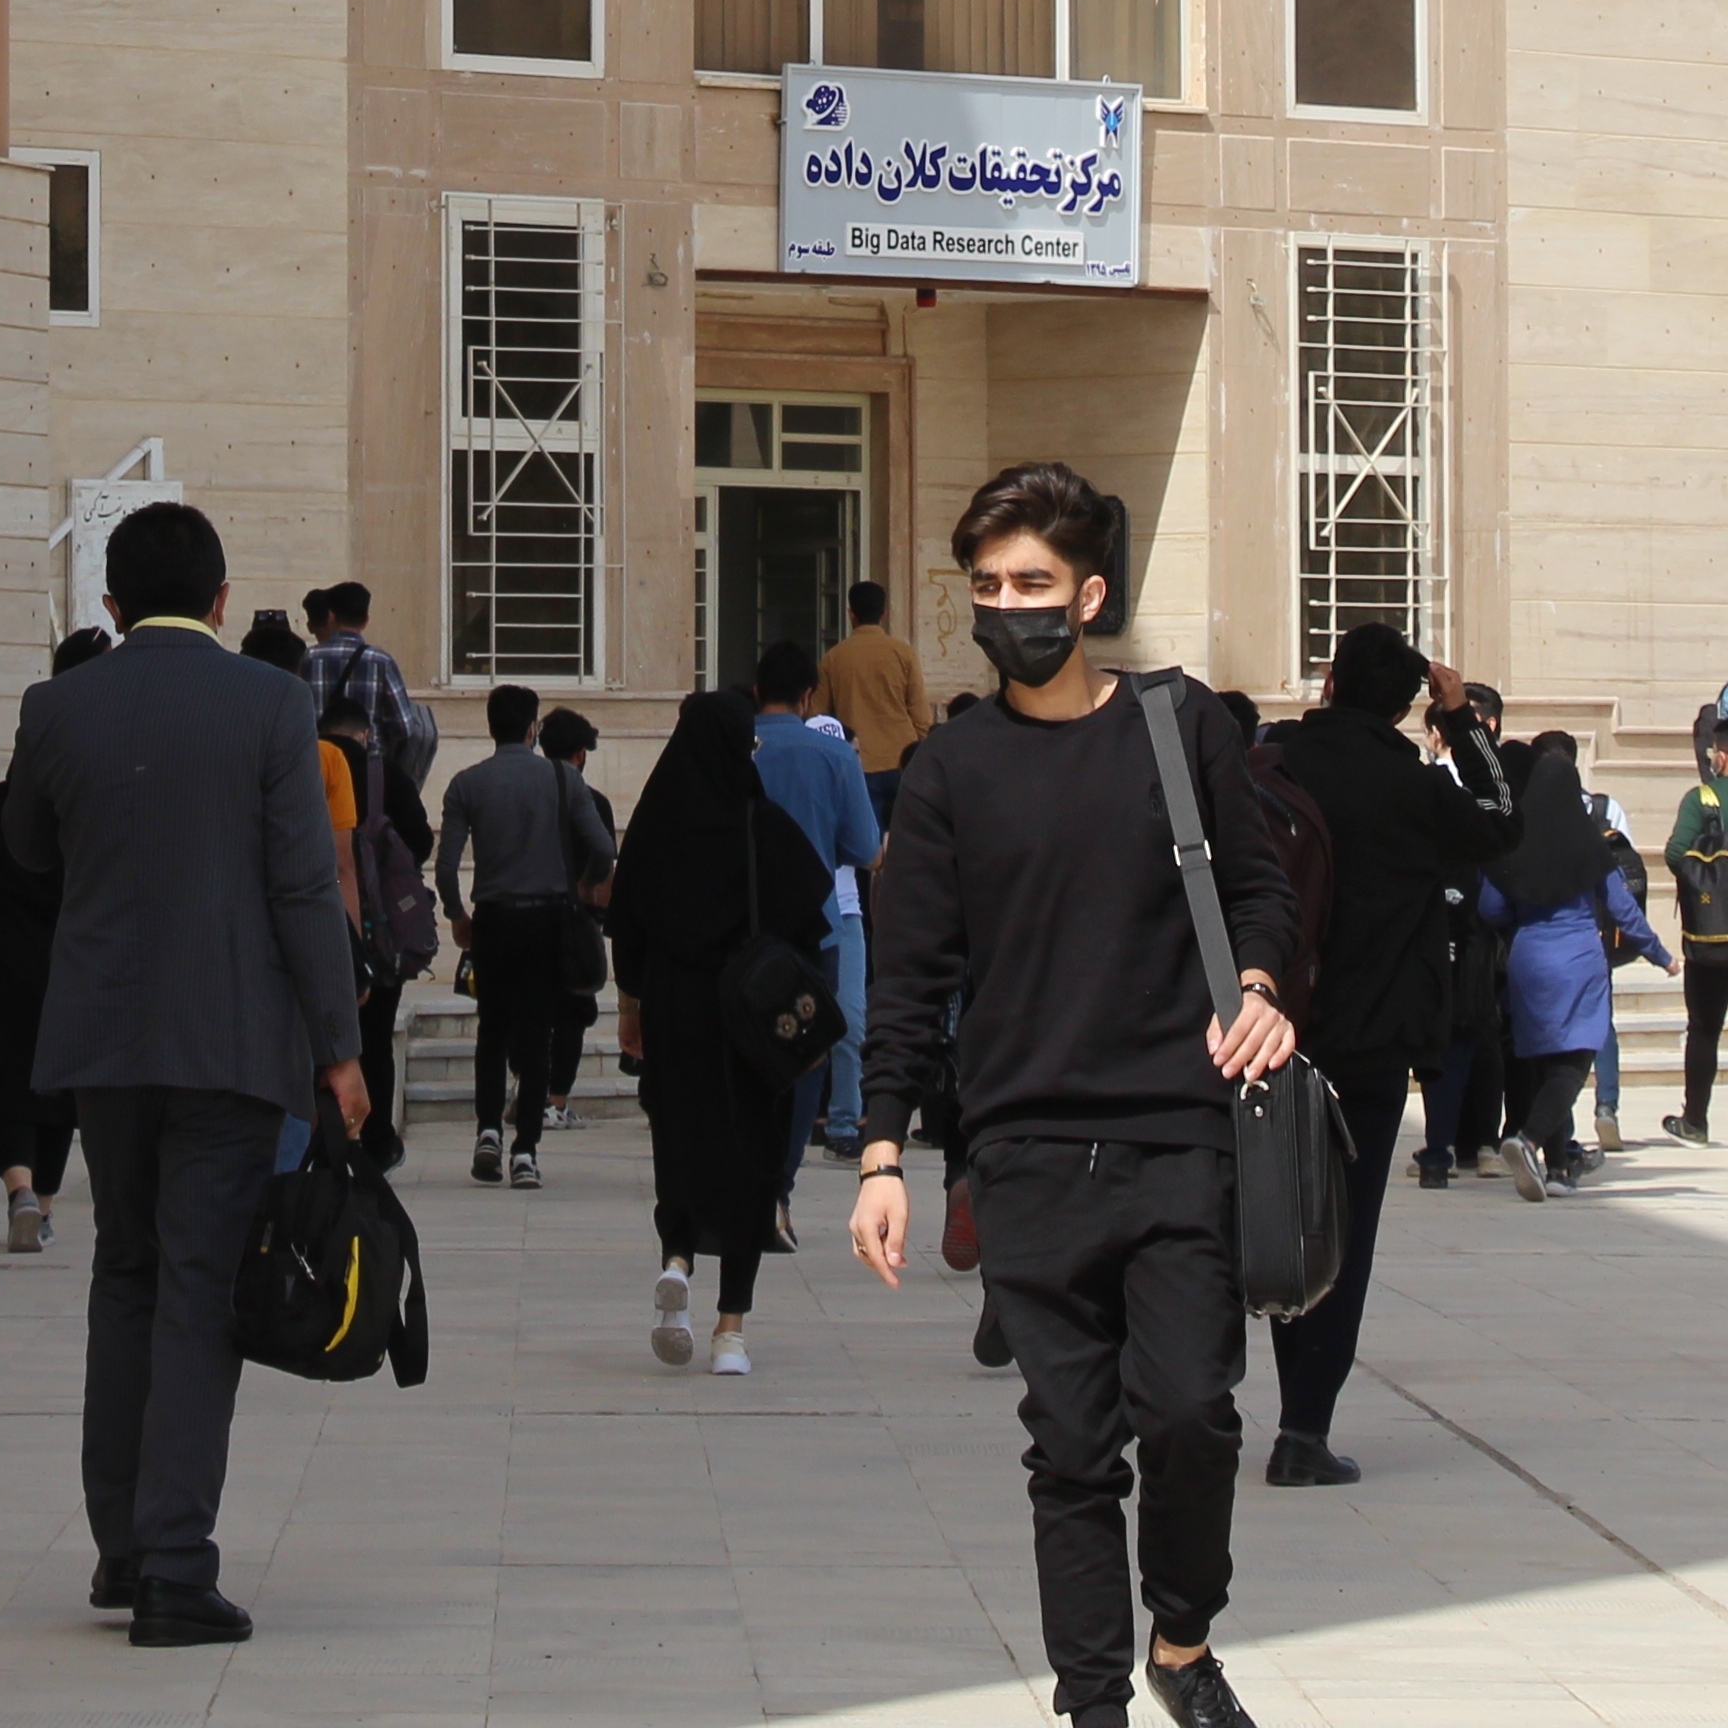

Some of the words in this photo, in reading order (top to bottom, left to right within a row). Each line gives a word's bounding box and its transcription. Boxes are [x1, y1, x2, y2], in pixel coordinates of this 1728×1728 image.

[806, 139, 873, 187] داده
[877, 139, 948, 202] کلان
[948, 146, 1062, 206] تحقیقات
[1060, 152, 1122, 213] مرکز
[788, 241, 810, 259] سوم
[811, 240, 836, 261] طبقه
[850, 226, 881, 255] Big
[886, 228, 927, 252] Data
[932, 230, 1016, 255] Research
[1021, 234, 1080, 258] Center
